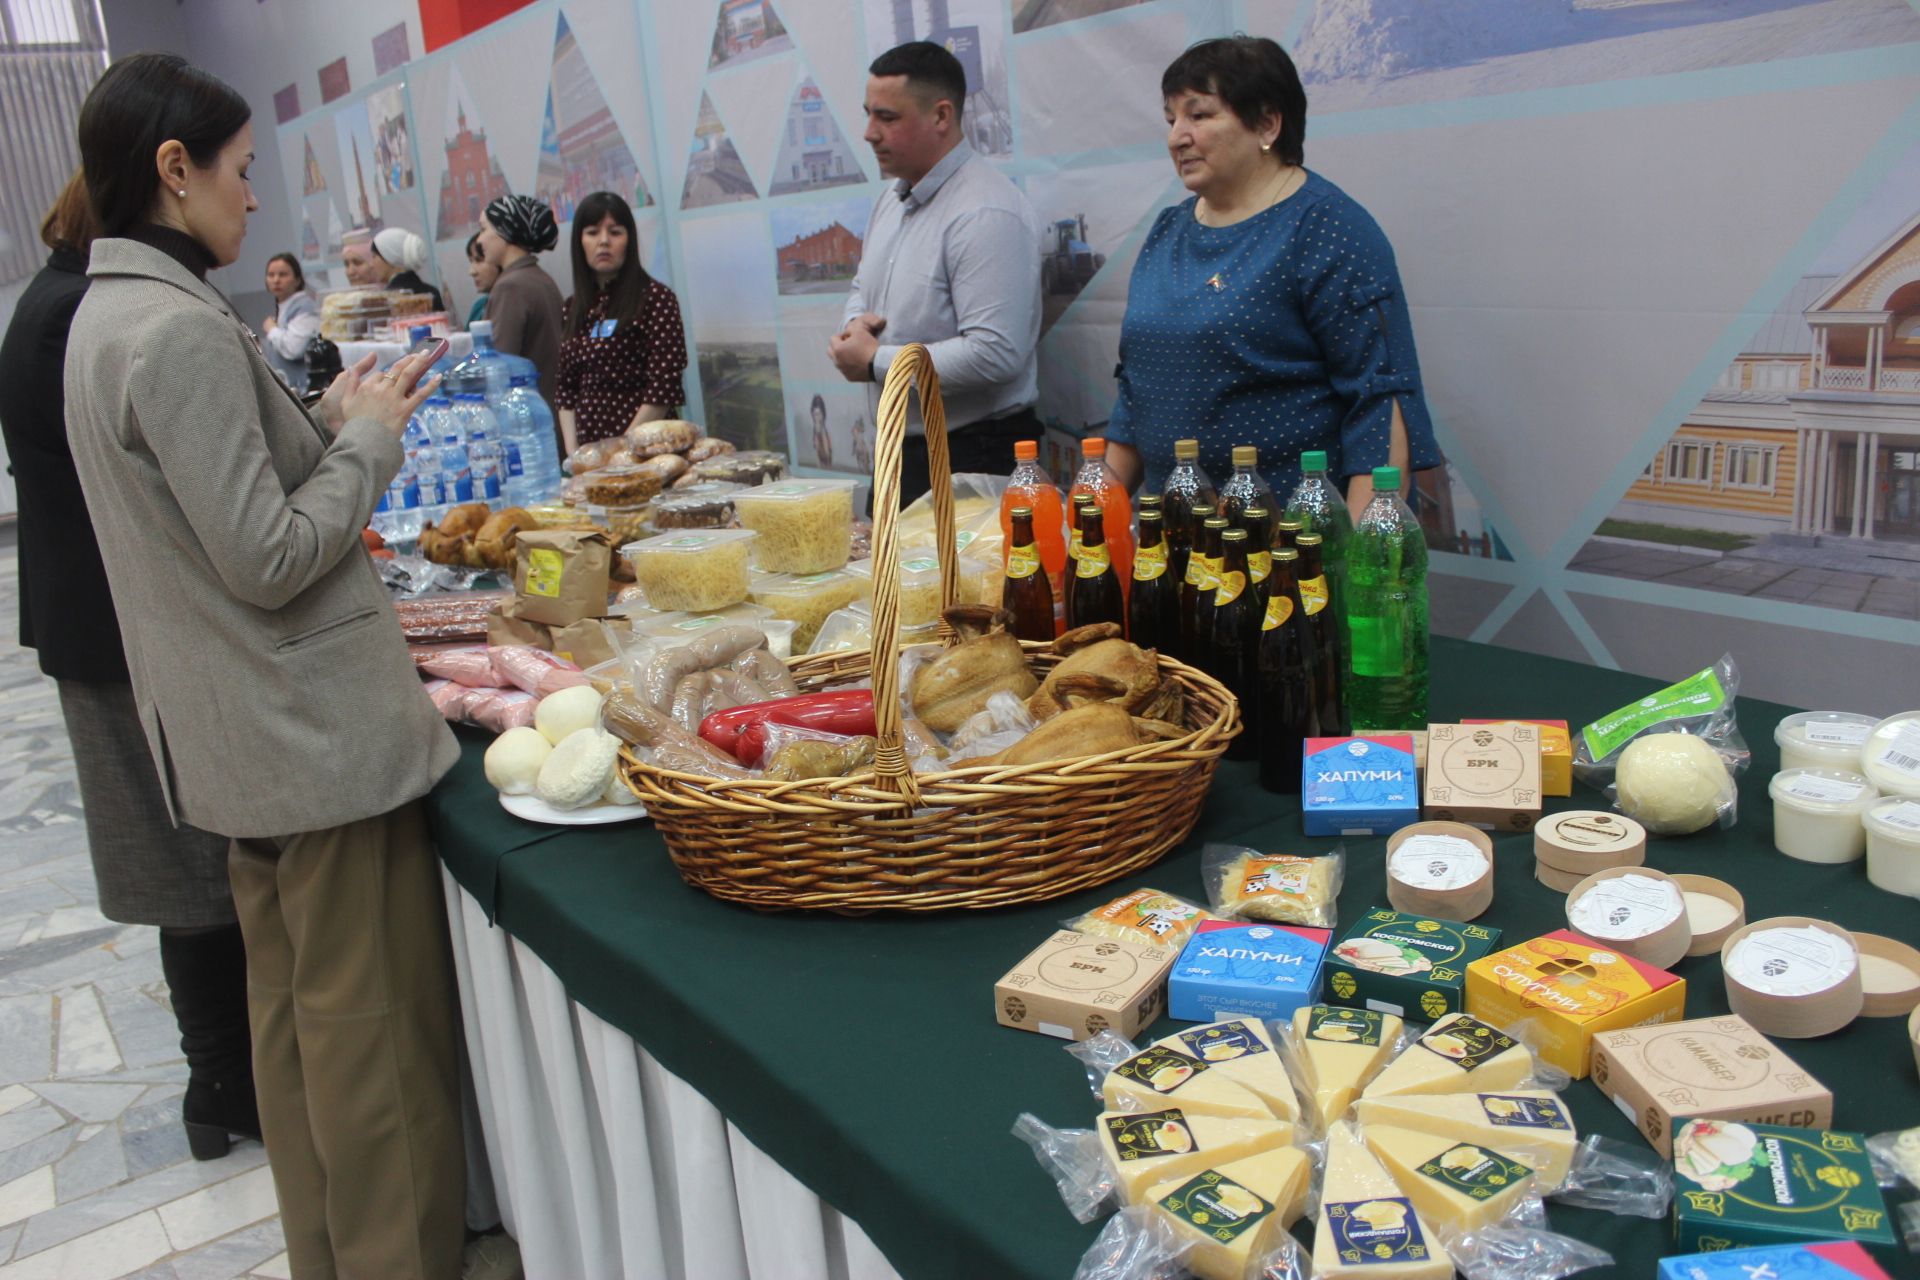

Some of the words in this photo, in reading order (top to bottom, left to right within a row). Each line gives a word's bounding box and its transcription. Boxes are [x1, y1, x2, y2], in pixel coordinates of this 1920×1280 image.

[1597, 713, 1637, 737] МАСЛО
[1466, 758, 1499, 768] БРИ
[1317, 770, 1403, 783] ХАЛУМИ
[1372, 932, 1457, 952] КОСТРОМСКОЙ
[1198, 946, 1304, 967] ХАЛУМИ
[1069, 960, 1107, 975] БРИ
[1492, 964, 1584, 1012] СУЛУГУНИ
[1676, 1036, 1737, 1083] КАМАМБЕР
[1763, 1137, 1797, 1206] КОСТРОМСКОЙ
[1348, 1227, 1407, 1240] ГОЛЛАНДСКИЙ
